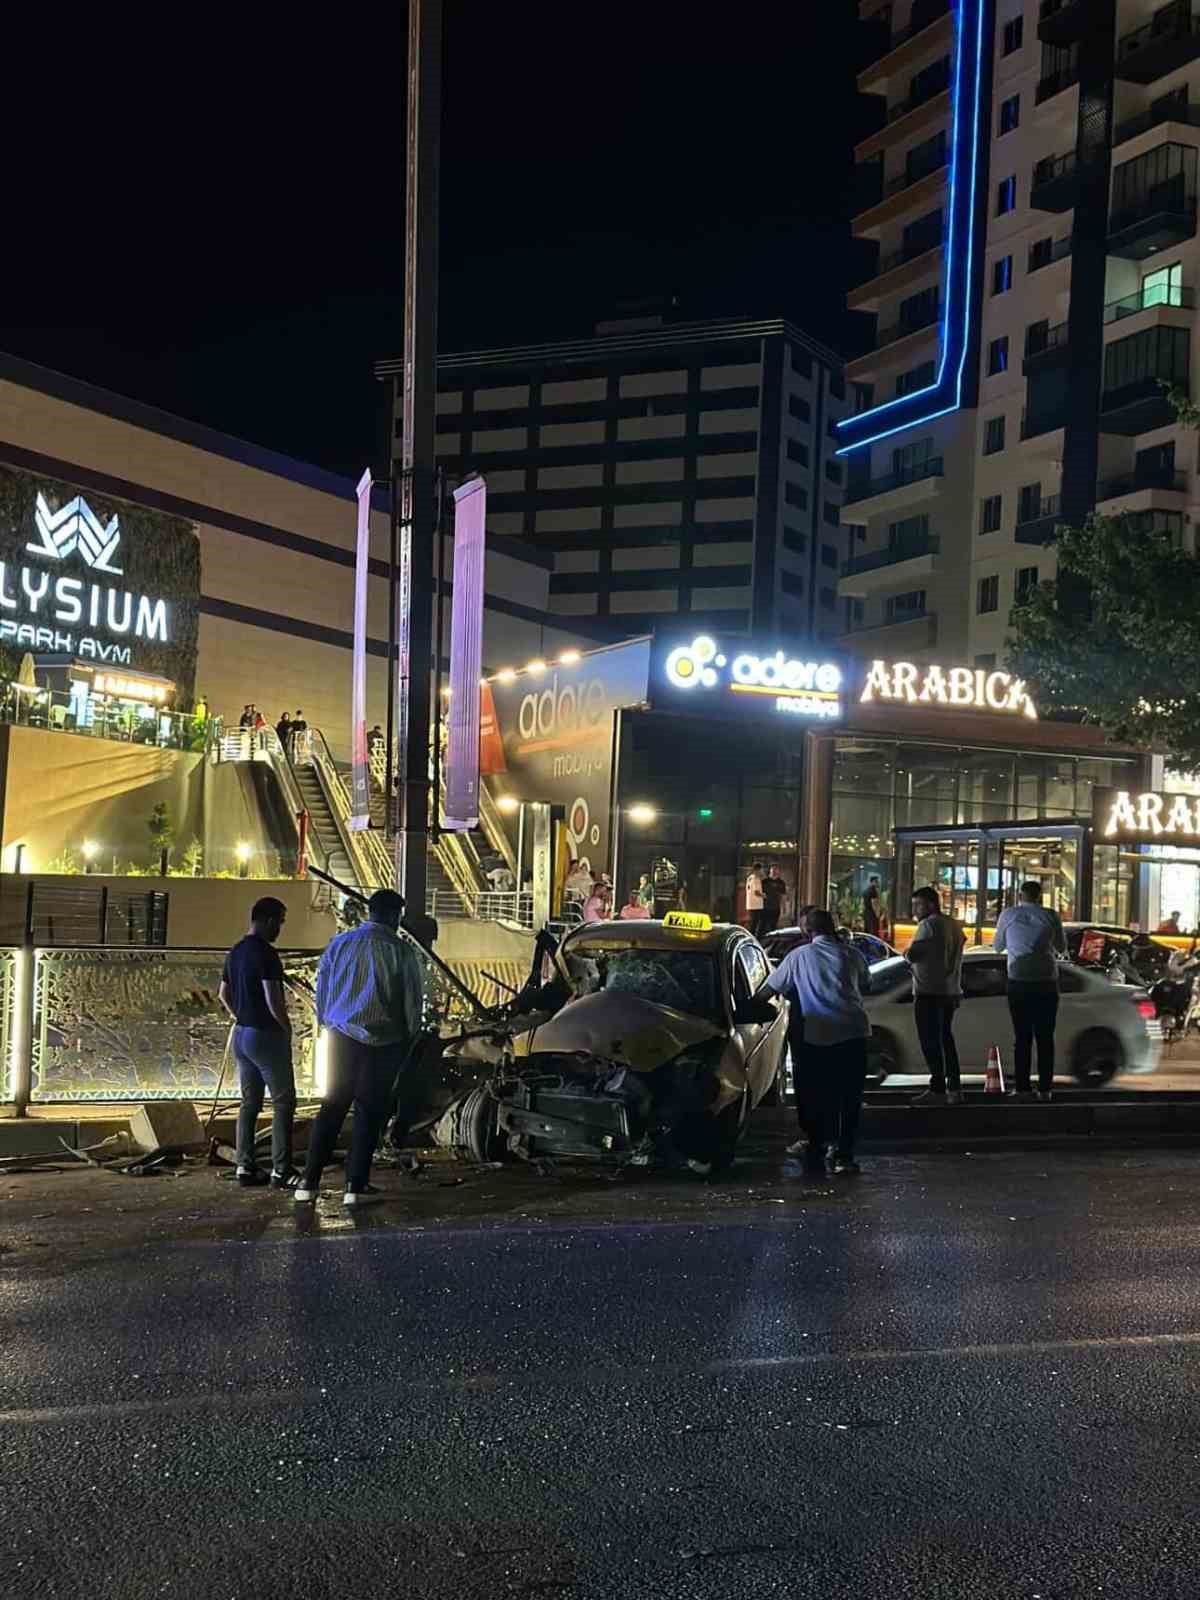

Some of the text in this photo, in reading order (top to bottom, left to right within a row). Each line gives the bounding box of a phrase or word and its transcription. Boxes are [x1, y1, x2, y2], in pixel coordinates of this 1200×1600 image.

[0, 619, 131, 664] PARK AVM
[732, 650, 841, 692] adore
[860, 660, 1038, 719] ARABICA
[1104, 791, 1200, 836] ARA
